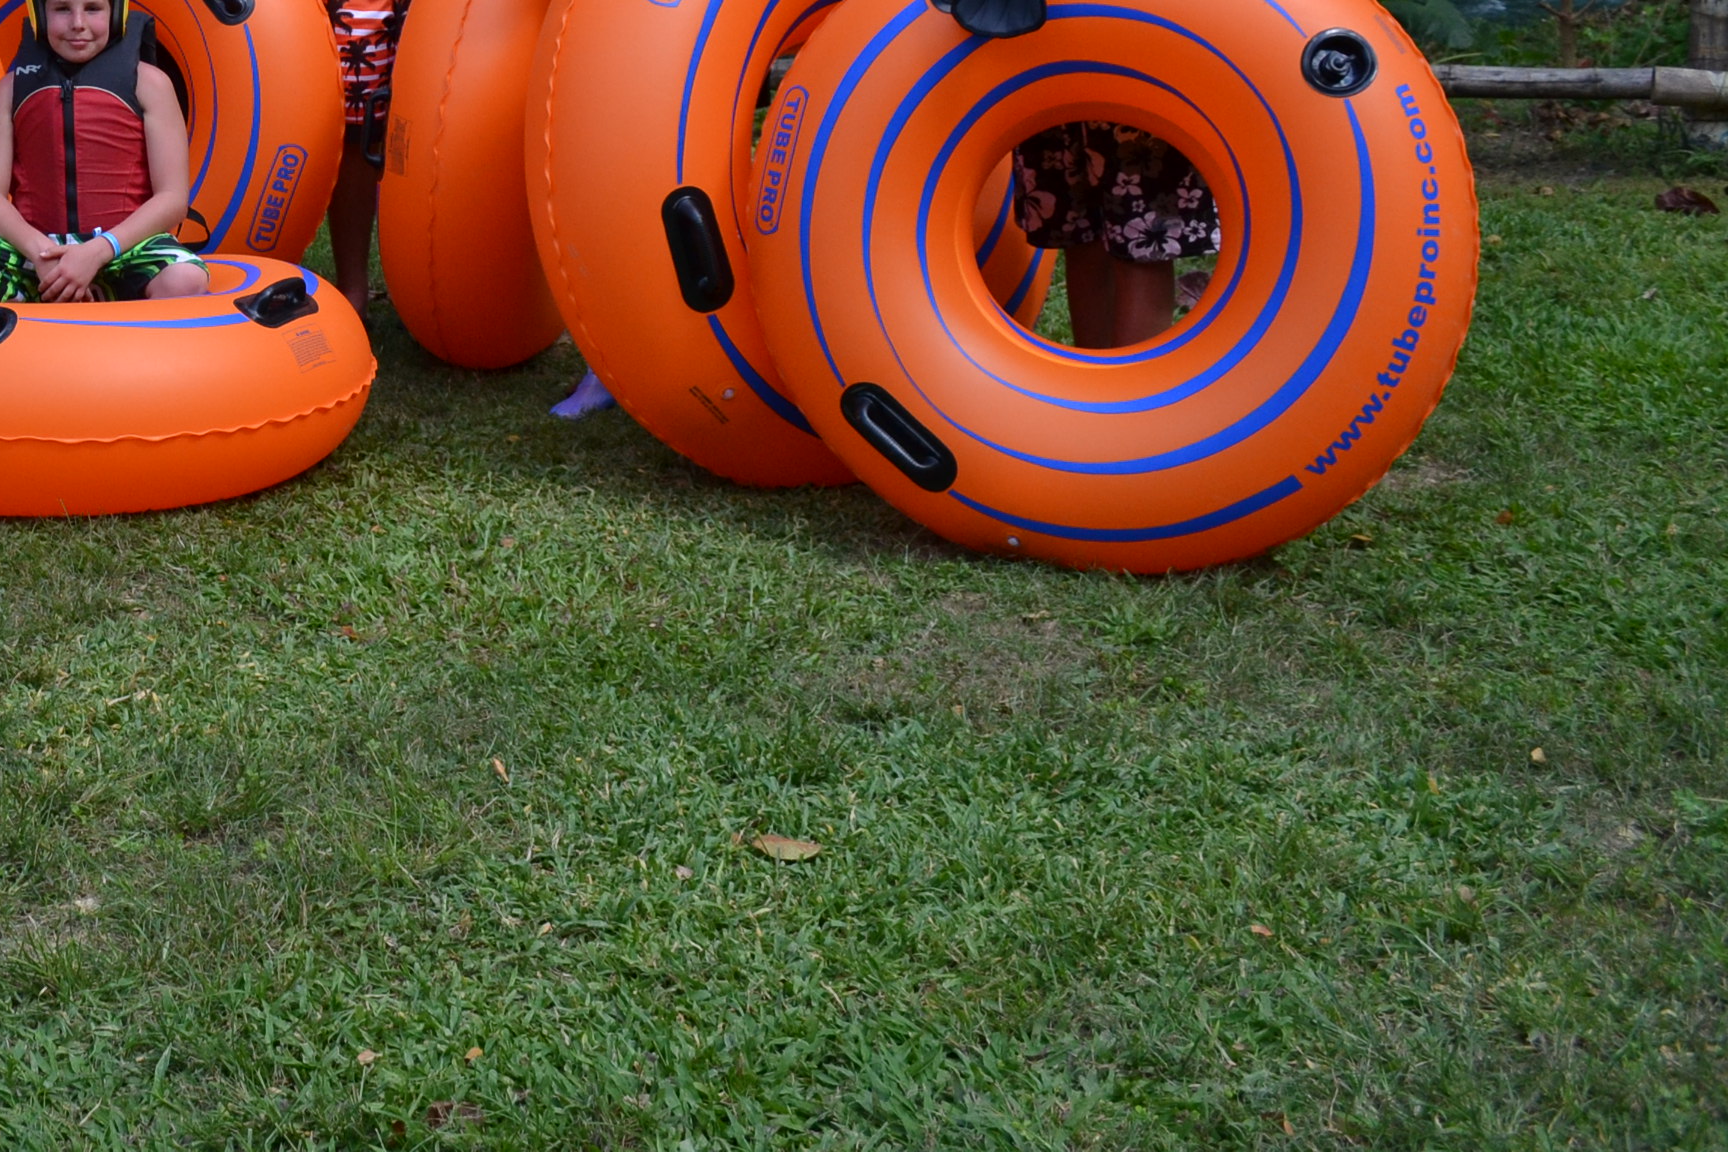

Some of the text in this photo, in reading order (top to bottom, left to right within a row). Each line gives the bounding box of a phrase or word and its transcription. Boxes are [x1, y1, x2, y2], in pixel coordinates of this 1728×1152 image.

[15, 64, 42, 76] NR
[254, 153, 299, 243] TUBE PRO
[760, 97, 801, 222] TUBE PRO
[1306, 83, 1440, 476] www.tubeproinc.com
